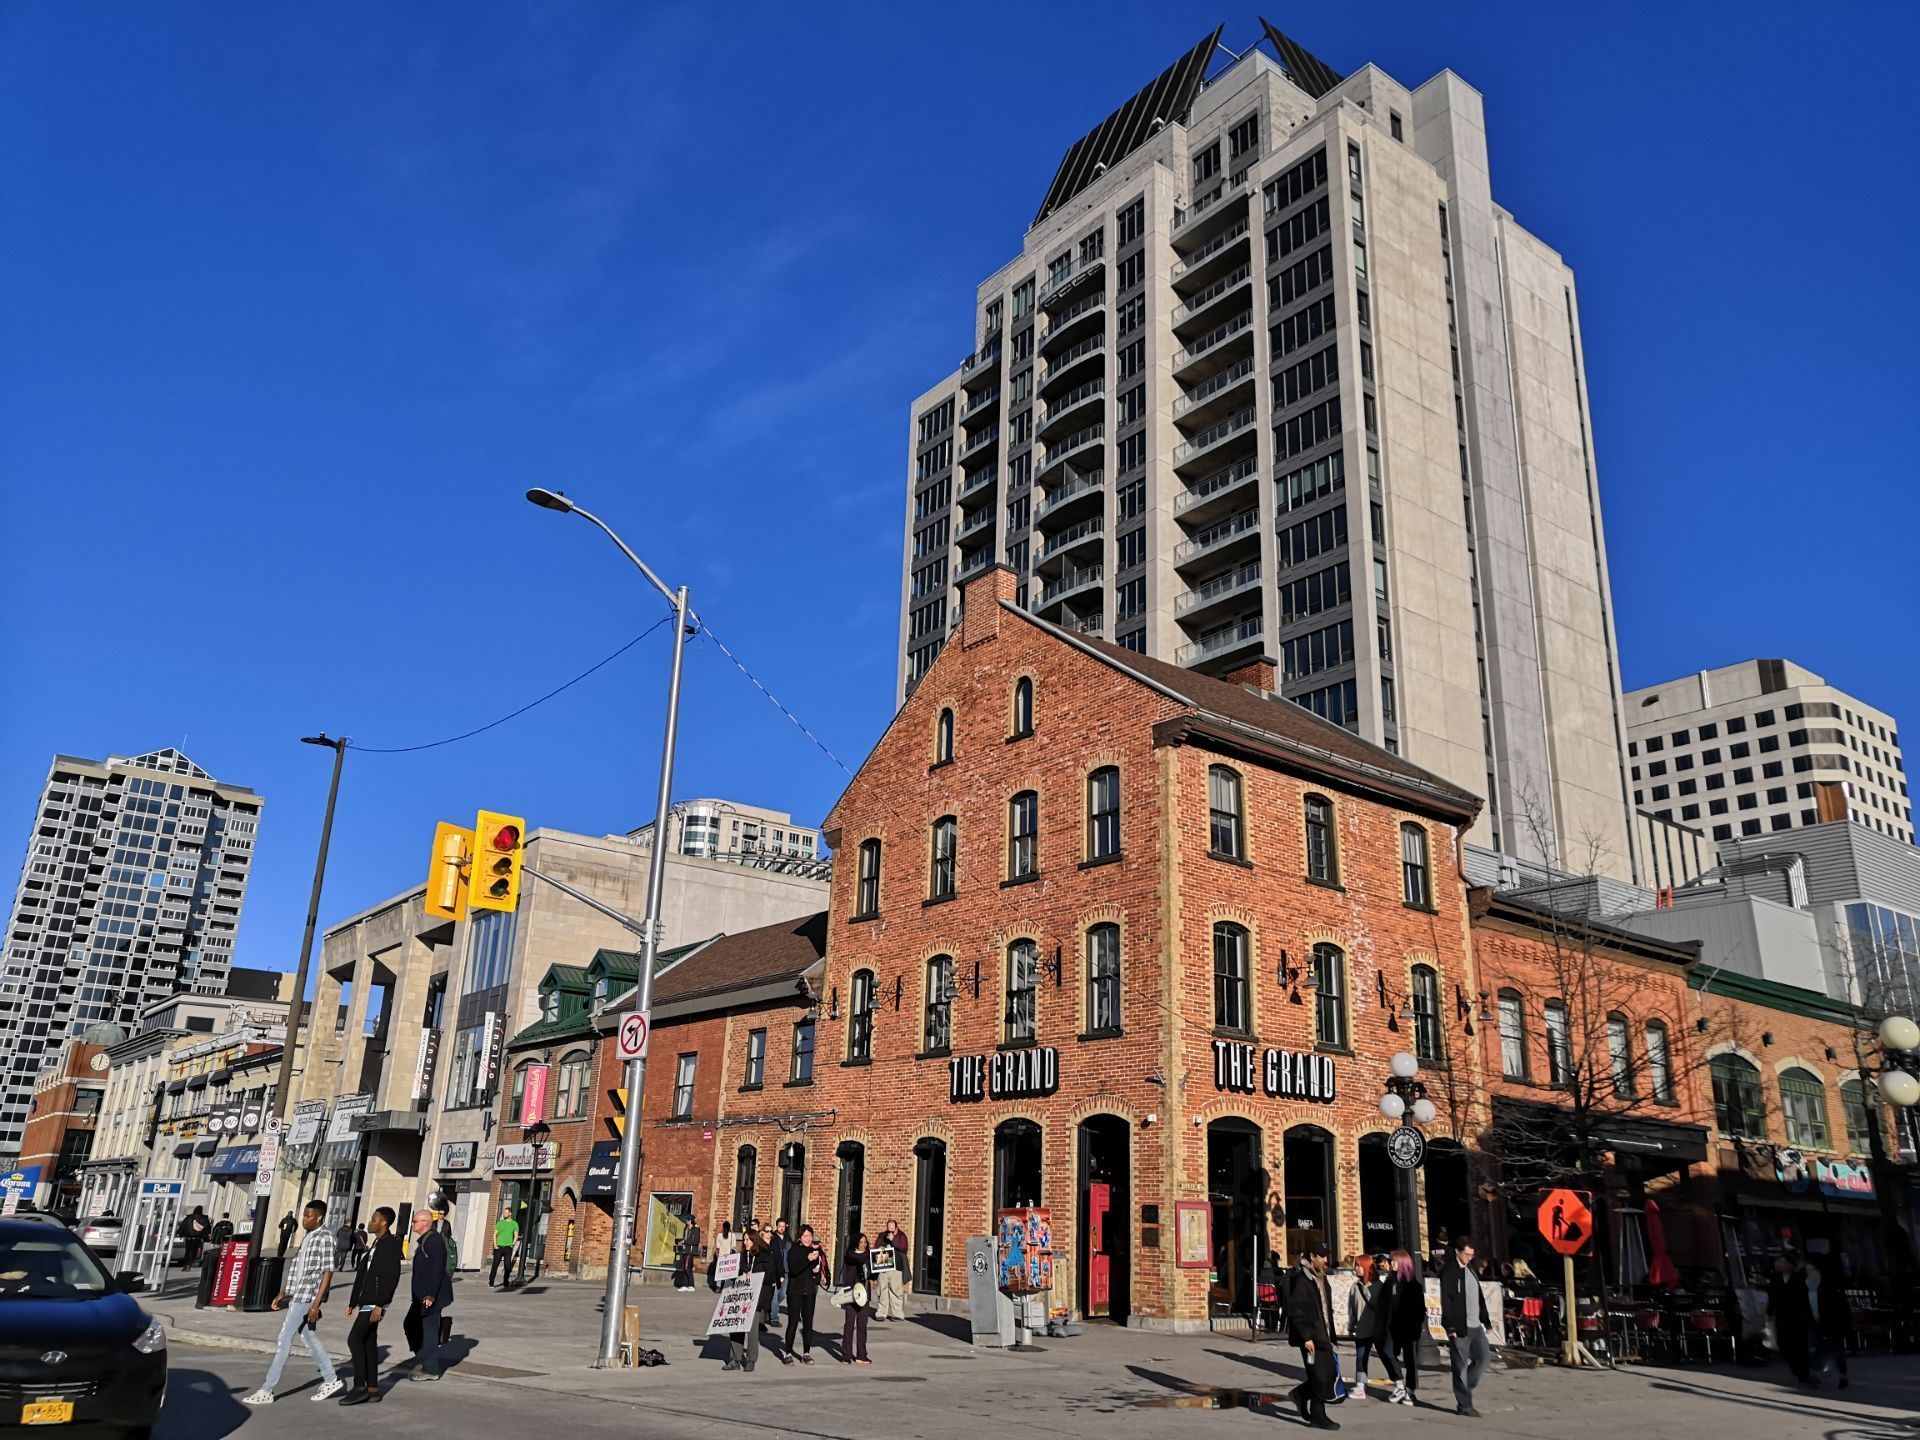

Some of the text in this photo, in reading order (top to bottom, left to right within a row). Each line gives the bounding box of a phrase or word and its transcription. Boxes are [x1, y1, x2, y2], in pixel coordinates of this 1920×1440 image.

[488, 1019, 502, 1079] rinaldo
[952, 1047, 1055, 1096] THE GRAND
[1215, 1041, 1334, 1099] THE GRAND
[1389, 1128, 1421, 1147] BYWARD MARKET
[1, 1177, 31, 1189] Corona
[153, 1183, 171, 1193] Bell
[1367, 1221, 1394, 1231] SALUMERIA
[227, 1262, 243, 1297] FREE
[723, 1292, 754, 1304] LIBERATION
[727, 1305, 740, 1315] END
[712, 1317, 746, 1328] SPECIESISM
